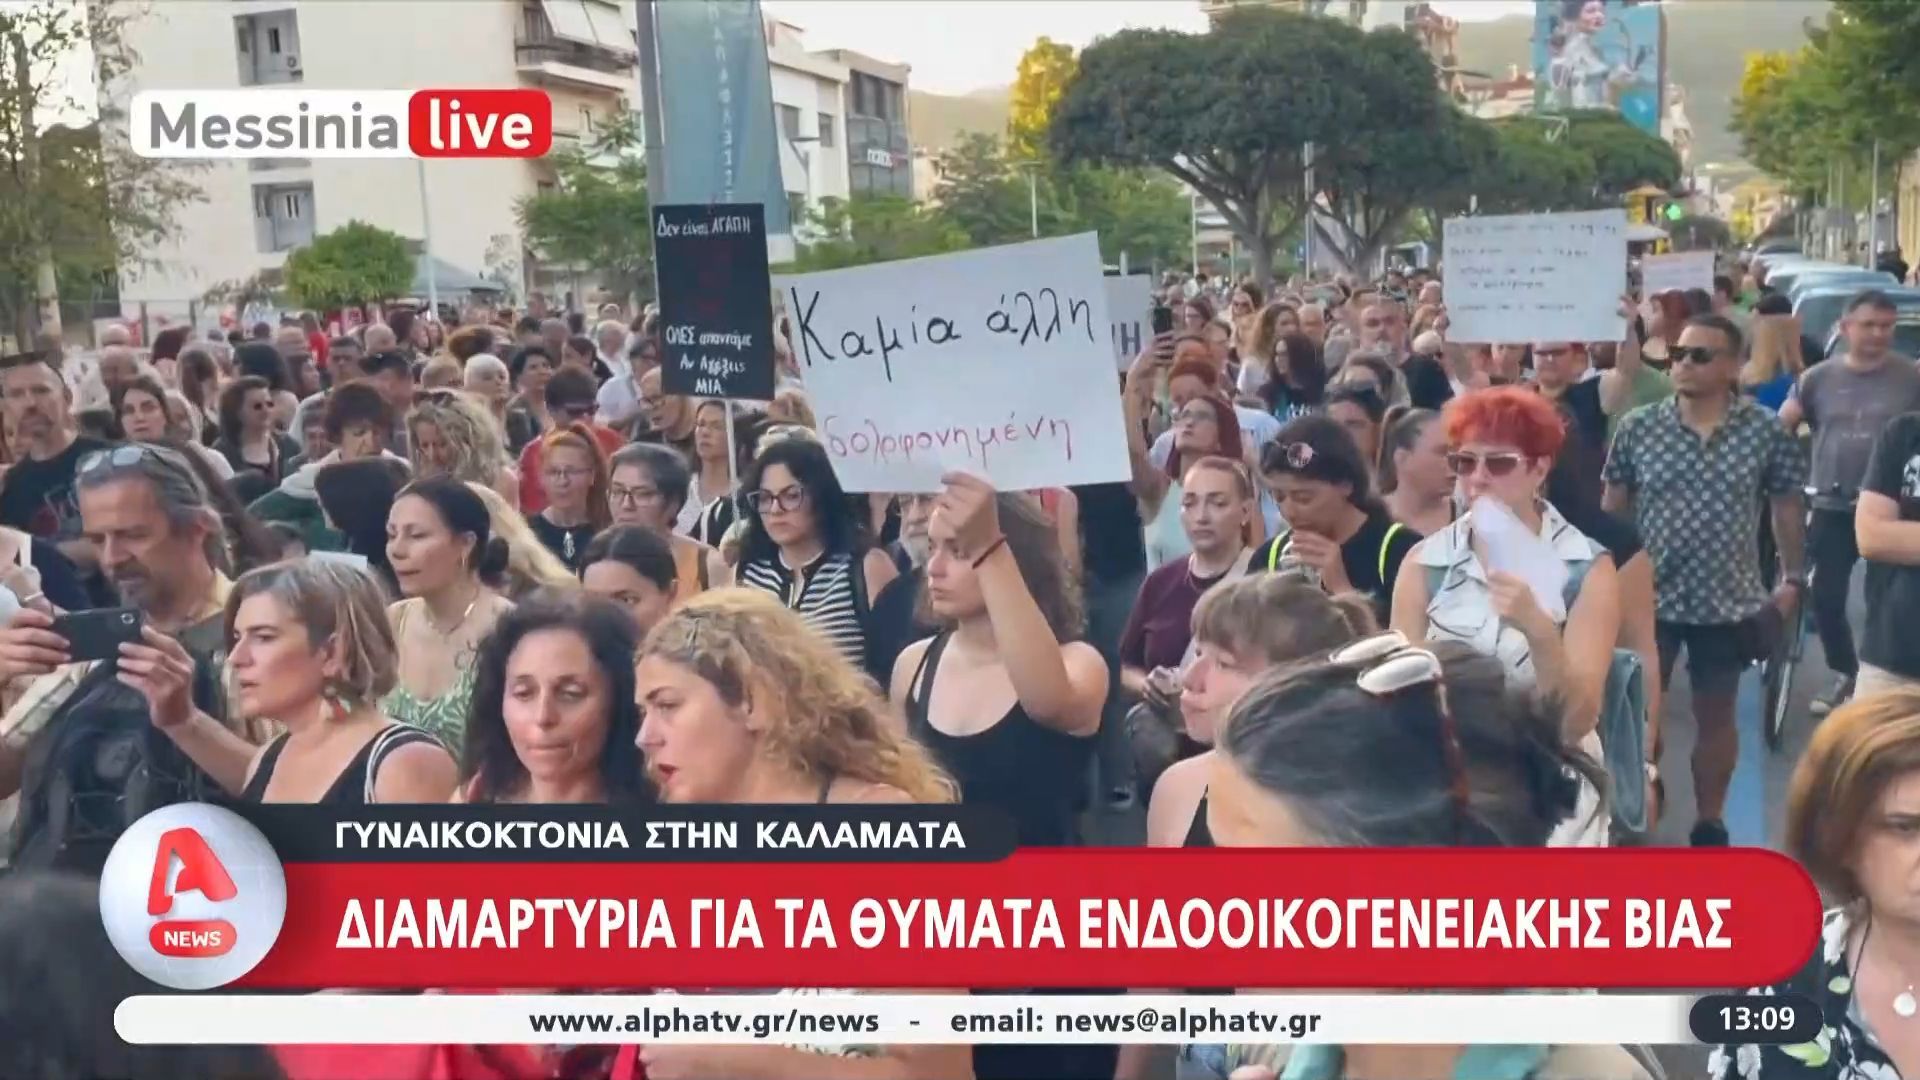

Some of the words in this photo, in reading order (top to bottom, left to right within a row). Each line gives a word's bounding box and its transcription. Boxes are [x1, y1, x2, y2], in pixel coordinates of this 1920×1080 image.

[657, 213, 680, 237] Δεν
[711, 215, 751, 234] ΑΓΑΠΗ
[665, 325, 697, 346] ΟΛΕΣ
[790, 286, 962, 383] Καμία
[986, 287, 1095, 346] άλλη
[680, 352, 695, 371] Αν
[823, 411, 1072, 469] δολοφονημένη
